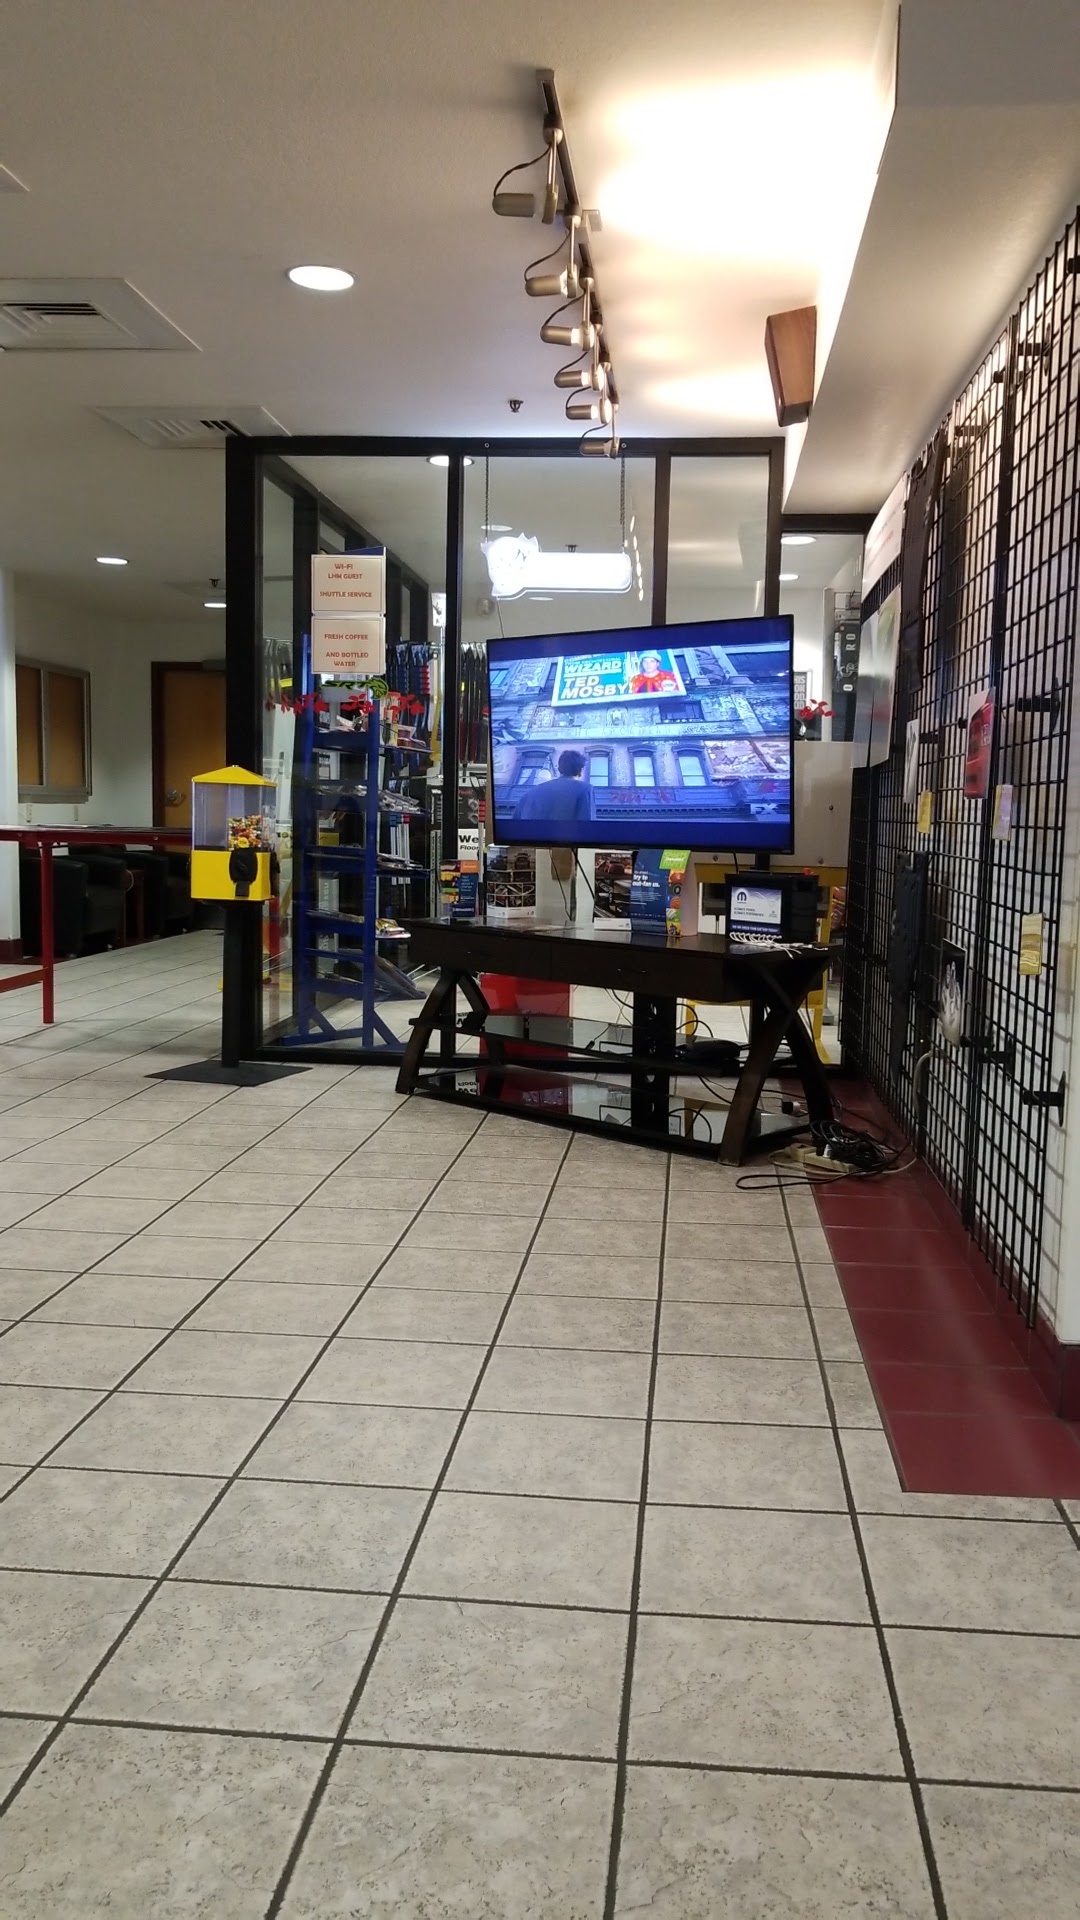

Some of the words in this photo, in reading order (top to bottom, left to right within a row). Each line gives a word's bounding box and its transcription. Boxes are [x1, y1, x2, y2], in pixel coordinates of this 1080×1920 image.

[565, 661, 622, 673] WIZARD
[321, 680, 367, 690] SRT
[564, 675, 600, 688] TED
[751, 803, 778, 815] FX
[459, 834, 480, 844] We
